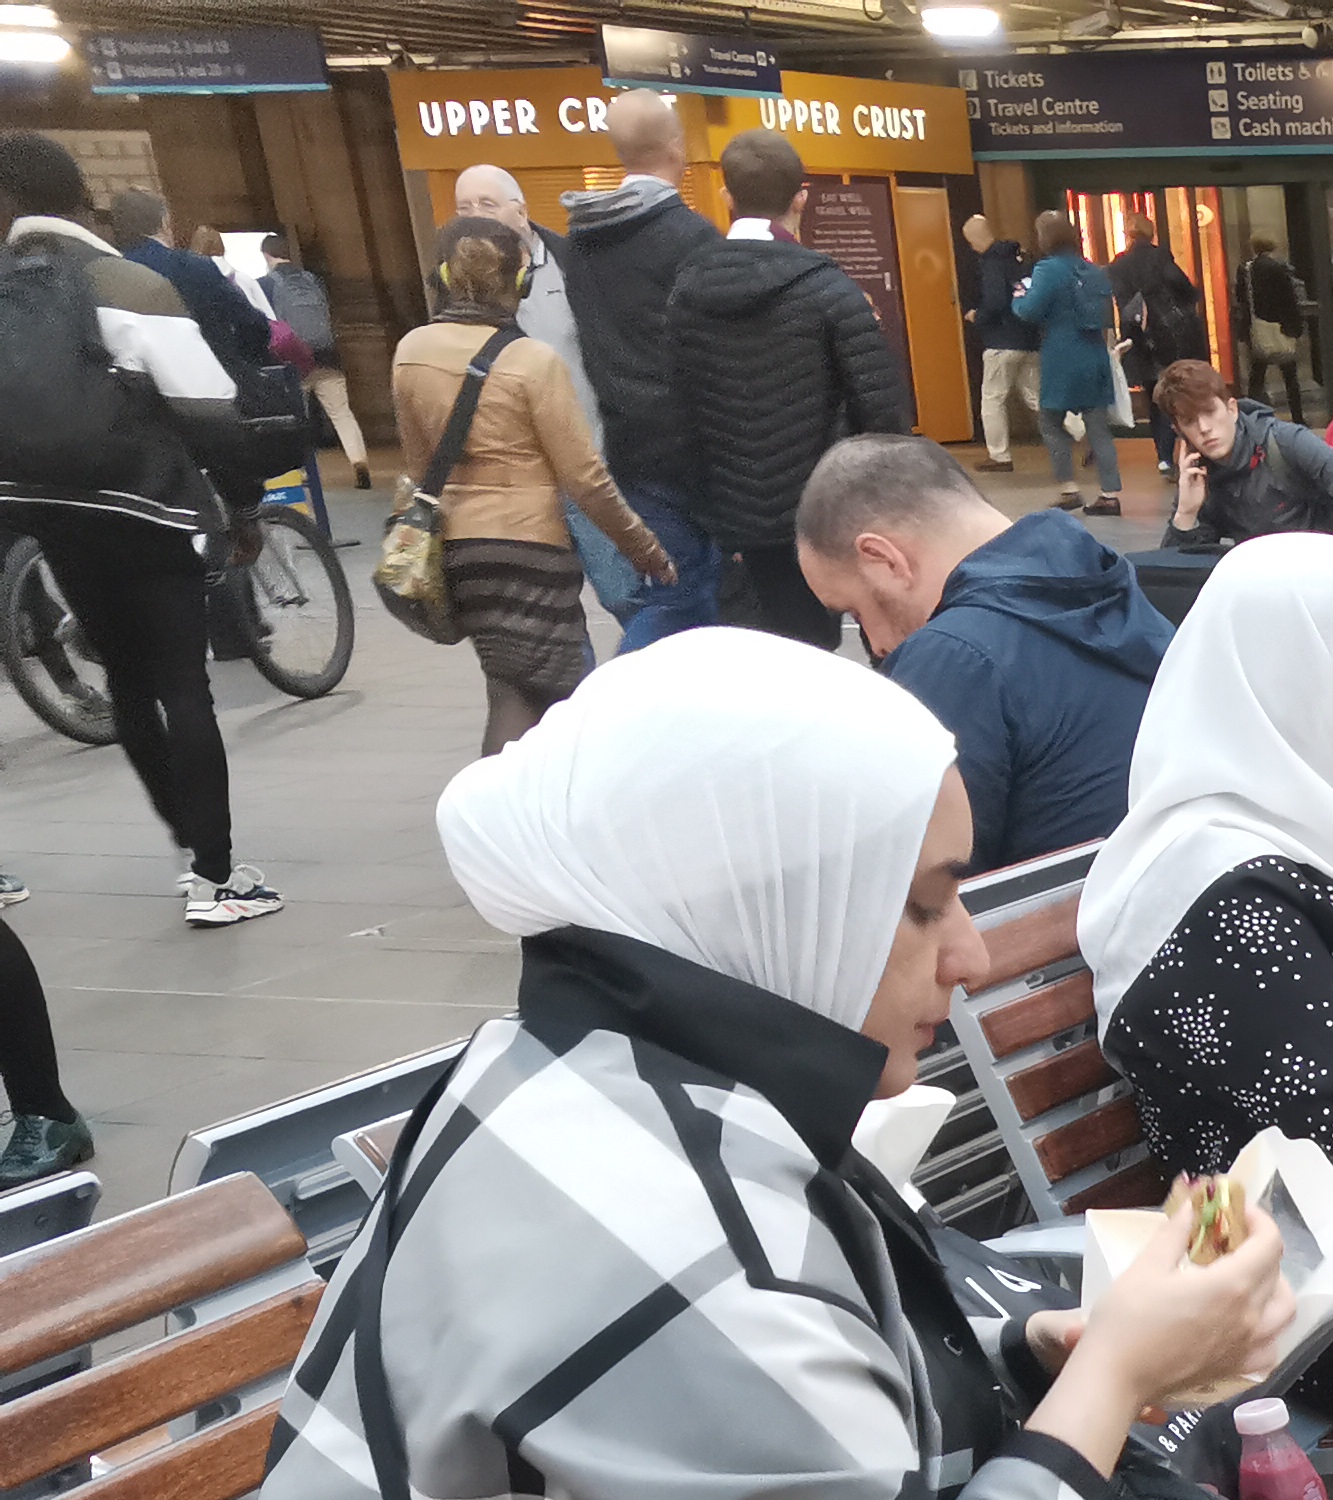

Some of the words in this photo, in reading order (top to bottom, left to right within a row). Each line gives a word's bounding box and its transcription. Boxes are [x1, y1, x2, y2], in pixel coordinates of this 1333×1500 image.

[984, 70, 1045, 89] Tickets
[1233, 62, 1294, 82] Toilets
[987, 98, 1038, 117] Travel
[1042, 97, 1100, 116] Centre
[1236, 91, 1303, 113] Seating
[419, 99, 539, 136] UPPER
[760, 98, 841, 135] UPPER
[853, 104, 927, 140] CRUST
[988, 121, 1031, 135] Tickets
[1032, 120, 1053, 134] and
[1238, 117, 1281, 136] Cash
[1158, 1435, 1178, 1453] &
